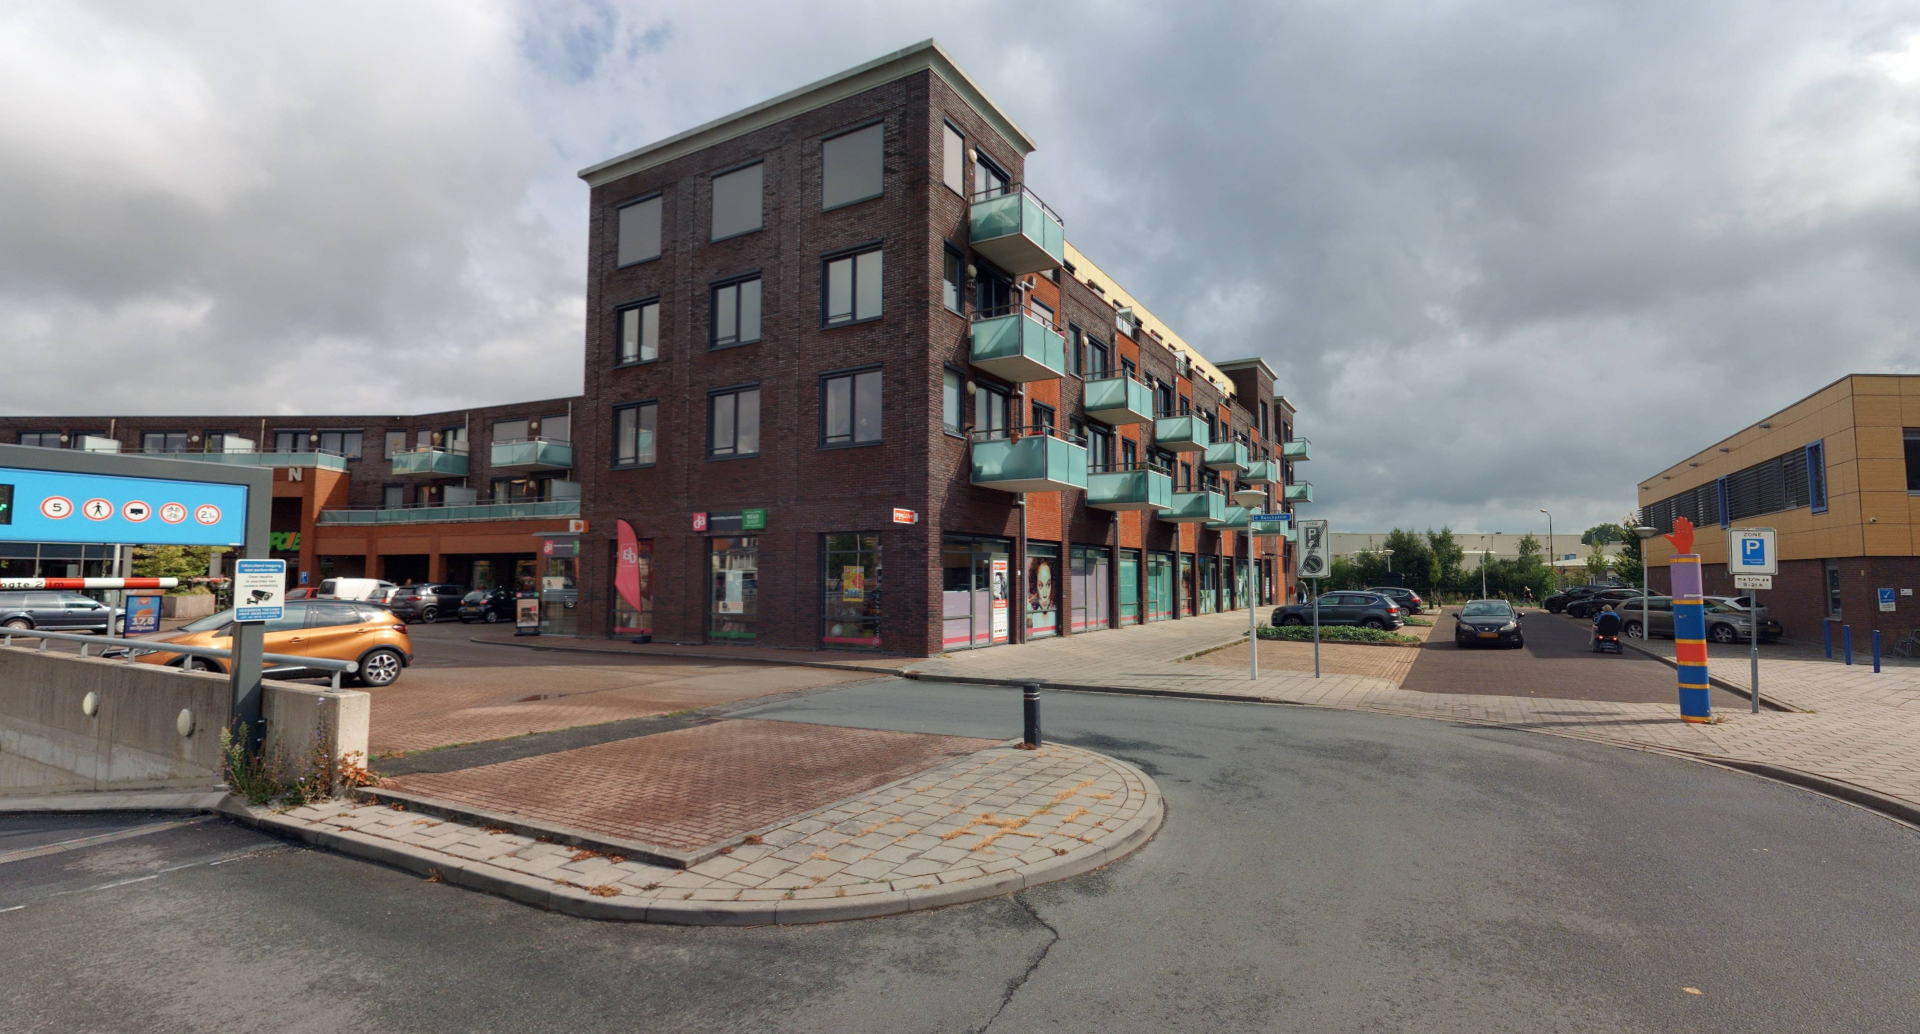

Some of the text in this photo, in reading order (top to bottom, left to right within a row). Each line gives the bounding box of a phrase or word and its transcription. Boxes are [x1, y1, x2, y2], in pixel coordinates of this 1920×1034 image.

[288, 467, 303, 481] N
[52, 502, 62, 512] 5
[693, 514, 706, 529] da
[1308, 528, 1317, 540] P
[1746, 540, 1760, 555] P
